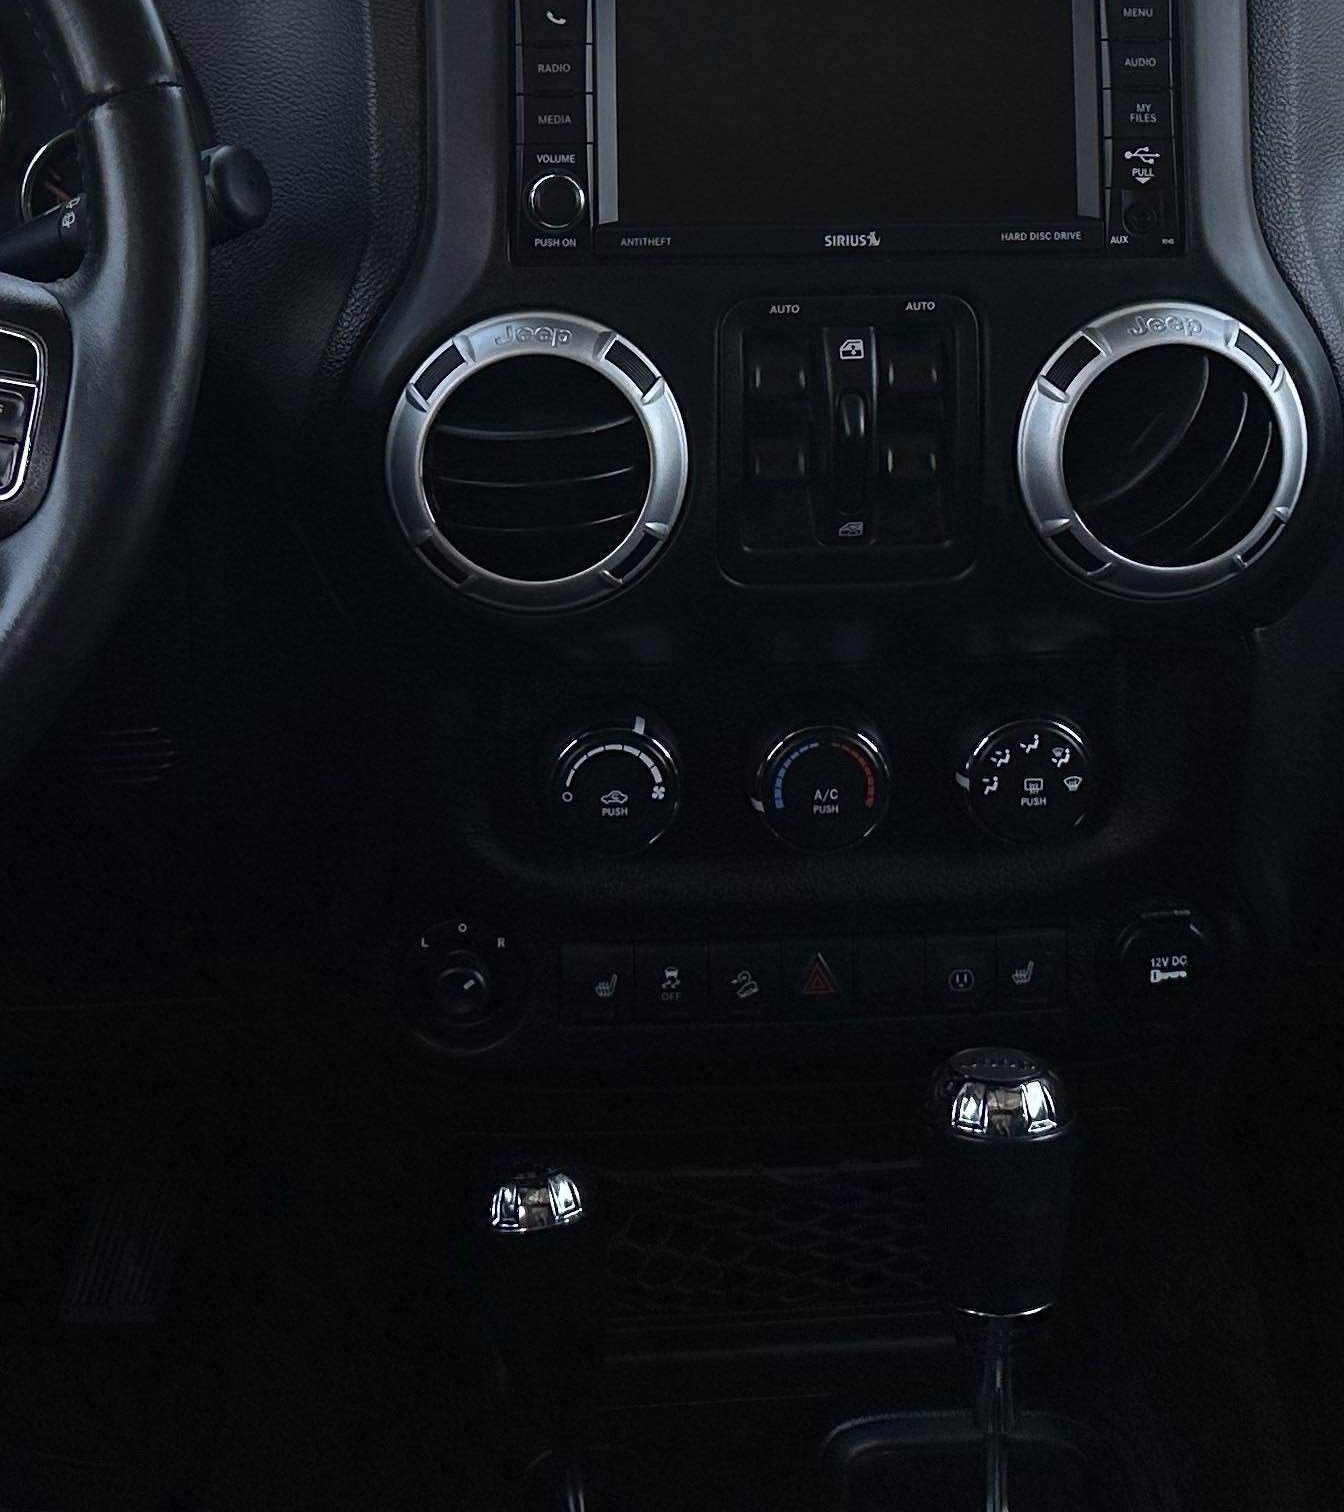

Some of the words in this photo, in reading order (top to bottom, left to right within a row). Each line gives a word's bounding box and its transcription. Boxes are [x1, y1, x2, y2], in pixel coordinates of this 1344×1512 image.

[1123, 7, 1154, 18] MENU
[537, 63, 571, 73] RADIO
[1124, 57, 1157, 68] AUDIO
[1136, 103, 1152, 113] MY
[538, 114, 572, 125] MEDIA
[1130, 113, 1157, 123] FILES
[536, 154, 576, 164] VOLUME
[1132, 167, 1155, 178] PULL
[621, 236, 672, 247] ANTITHEFT
[824, 234, 867, 248] SIRIUS
[1001, 232, 1028, 242] HARD
[1029, 231, 1052, 241] DISC
[1053, 231, 1082, 241] DRIVE
[1110, 235, 1129, 245] AUX
[534, 238, 561, 248] PUSH
[562, 238, 577, 248] ON
[769, 303, 800, 315] AUTO
[905, 301, 936, 312] AUTO
[1127, 315, 1203, 337] Jeep
[494, 323, 573, 348] Jeep
[814, 787, 839, 801] A/C
[1020, 795, 1047, 807] PUSH
[601, 806, 629, 817] PUSH
[813, 804, 839, 815] PUSH
[497, 937, 506, 948] R
[1150, 957, 1169, 968] 12V
[1171, 955, 1188, 966] DC
[661, 992, 682, 1001] OFF
